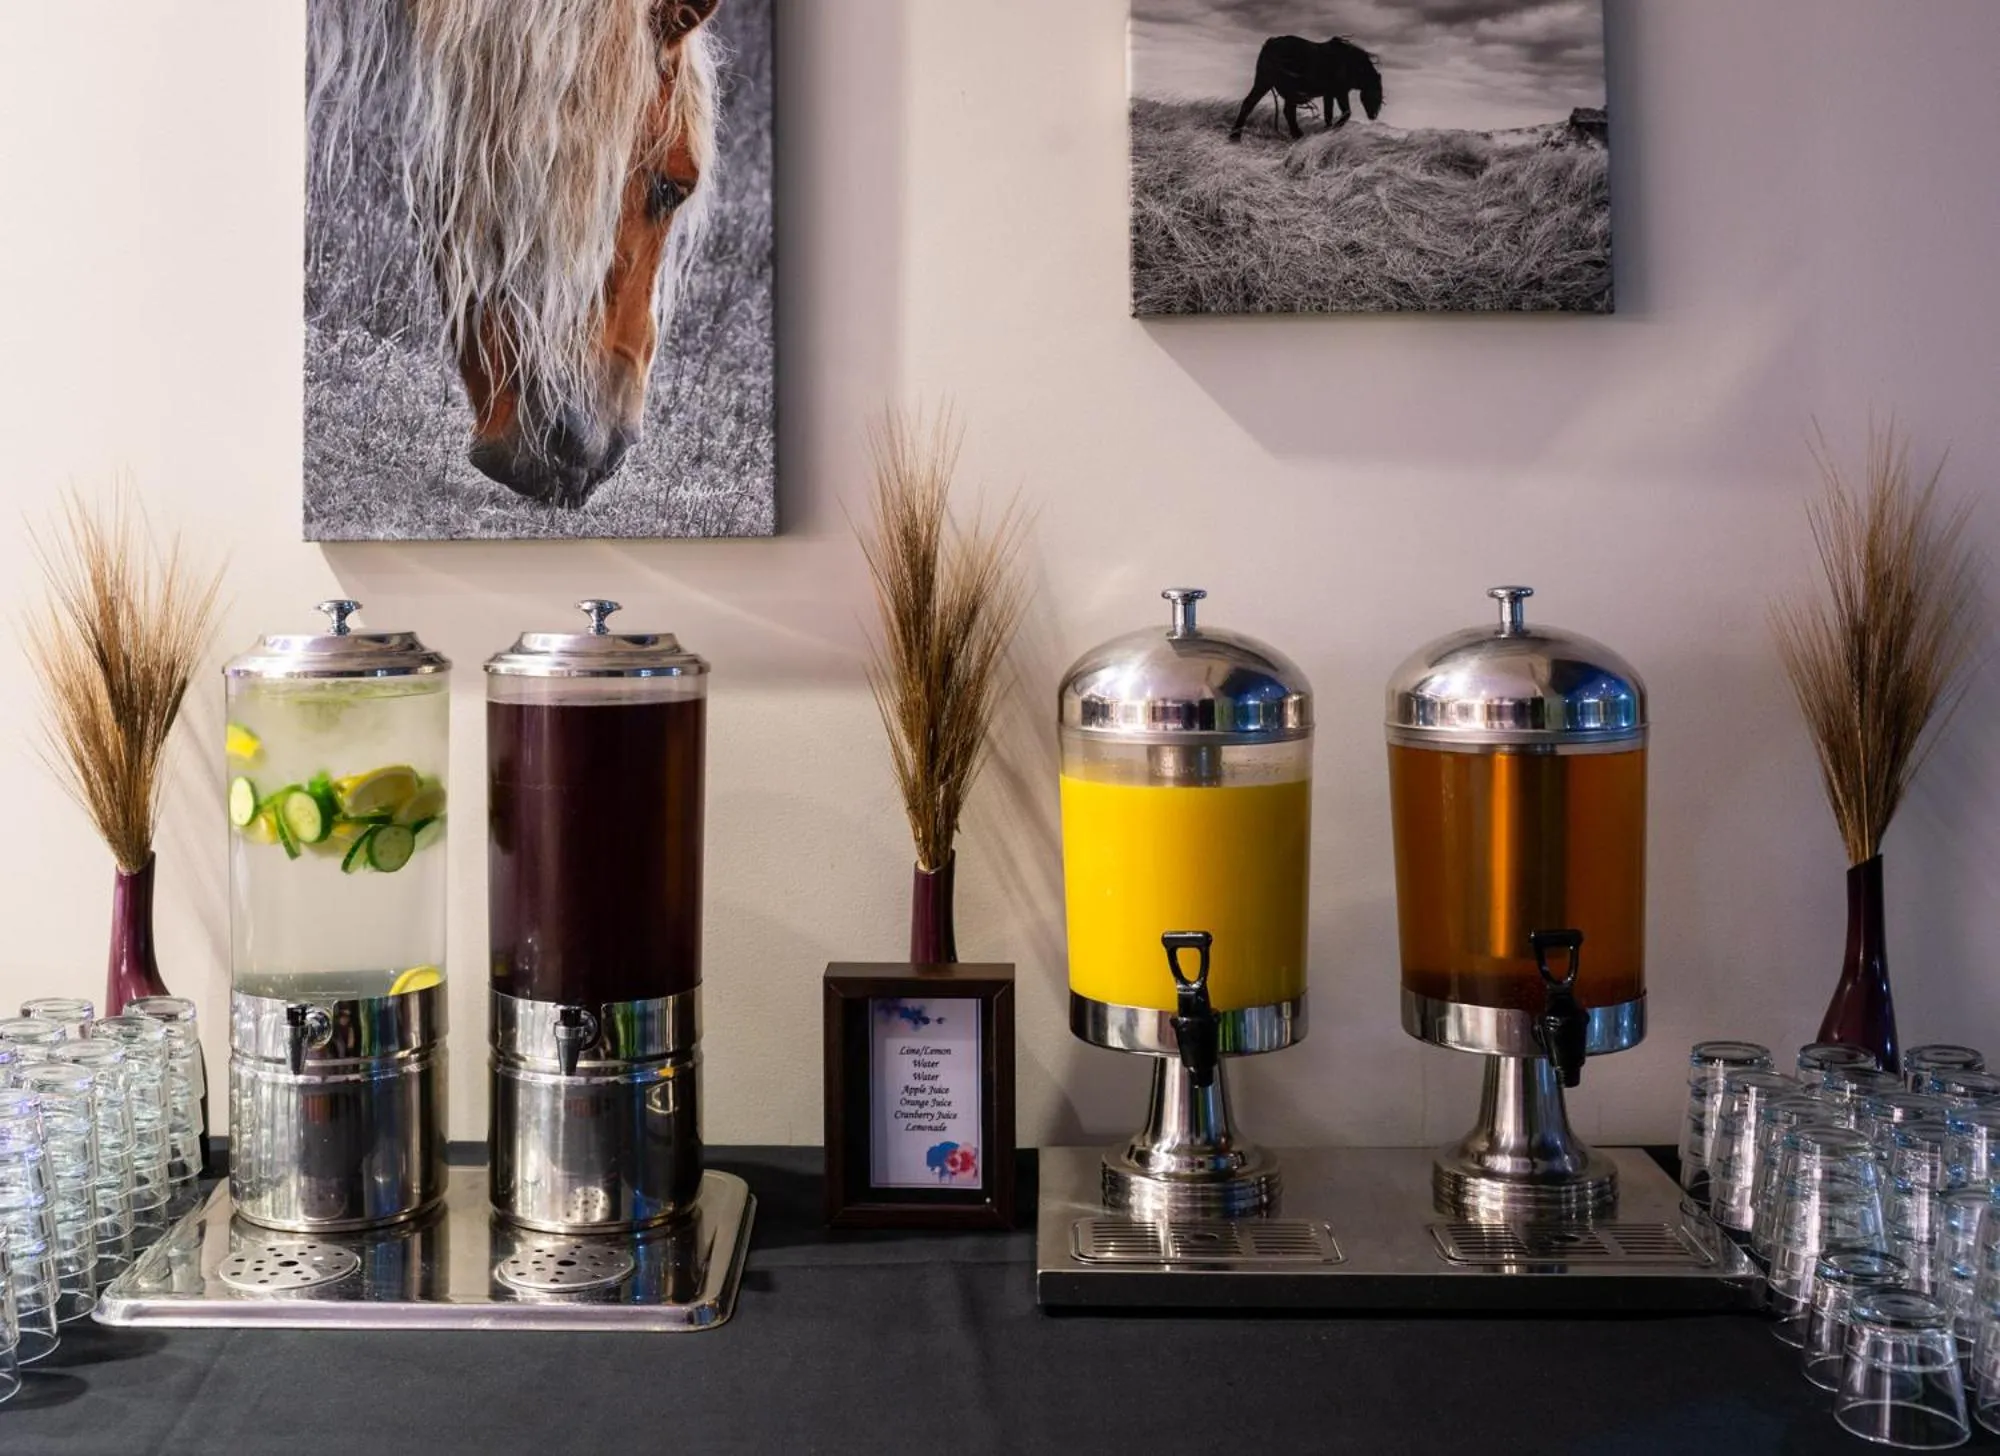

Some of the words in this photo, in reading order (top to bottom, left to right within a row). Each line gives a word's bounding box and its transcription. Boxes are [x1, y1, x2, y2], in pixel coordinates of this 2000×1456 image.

[899, 1045, 952, 1056] Lime/Lemon
[912, 1059, 940, 1068] Water
[912, 1072, 940, 1081] Water
[901, 1084, 926, 1096] Apple
[928, 1085, 950, 1095] Juice
[899, 1098, 929, 1108] Orange
[931, 1098, 952, 1108] Juice
[894, 1110, 934, 1122] Cranberry
[936, 1111, 958, 1121] Juice
[904, 1123, 947, 1132] Lemonade
